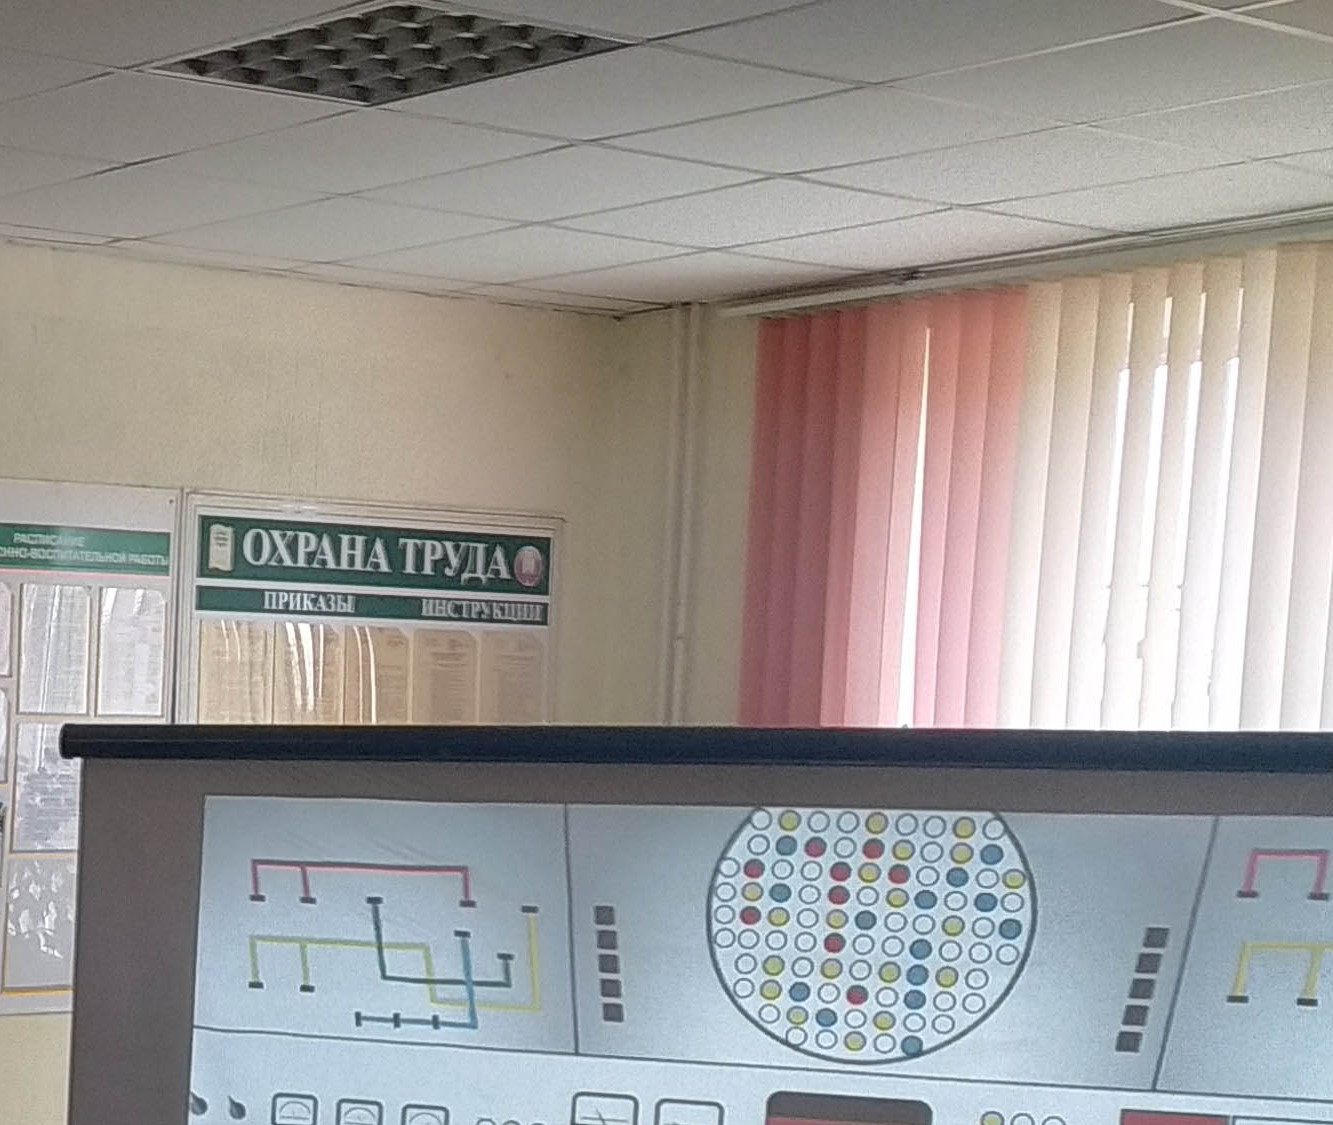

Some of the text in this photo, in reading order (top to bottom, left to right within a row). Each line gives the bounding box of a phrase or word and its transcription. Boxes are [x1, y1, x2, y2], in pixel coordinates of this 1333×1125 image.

[13, 532, 85, 547] РАСПИСАНИЕ
[242, 527, 514, 585] ОХРАНА ТРУДА
[263, 590, 356, 614] ПРИКАЗЫ
[421, 598, 545, 622] ИНСТРУКЦИИ
